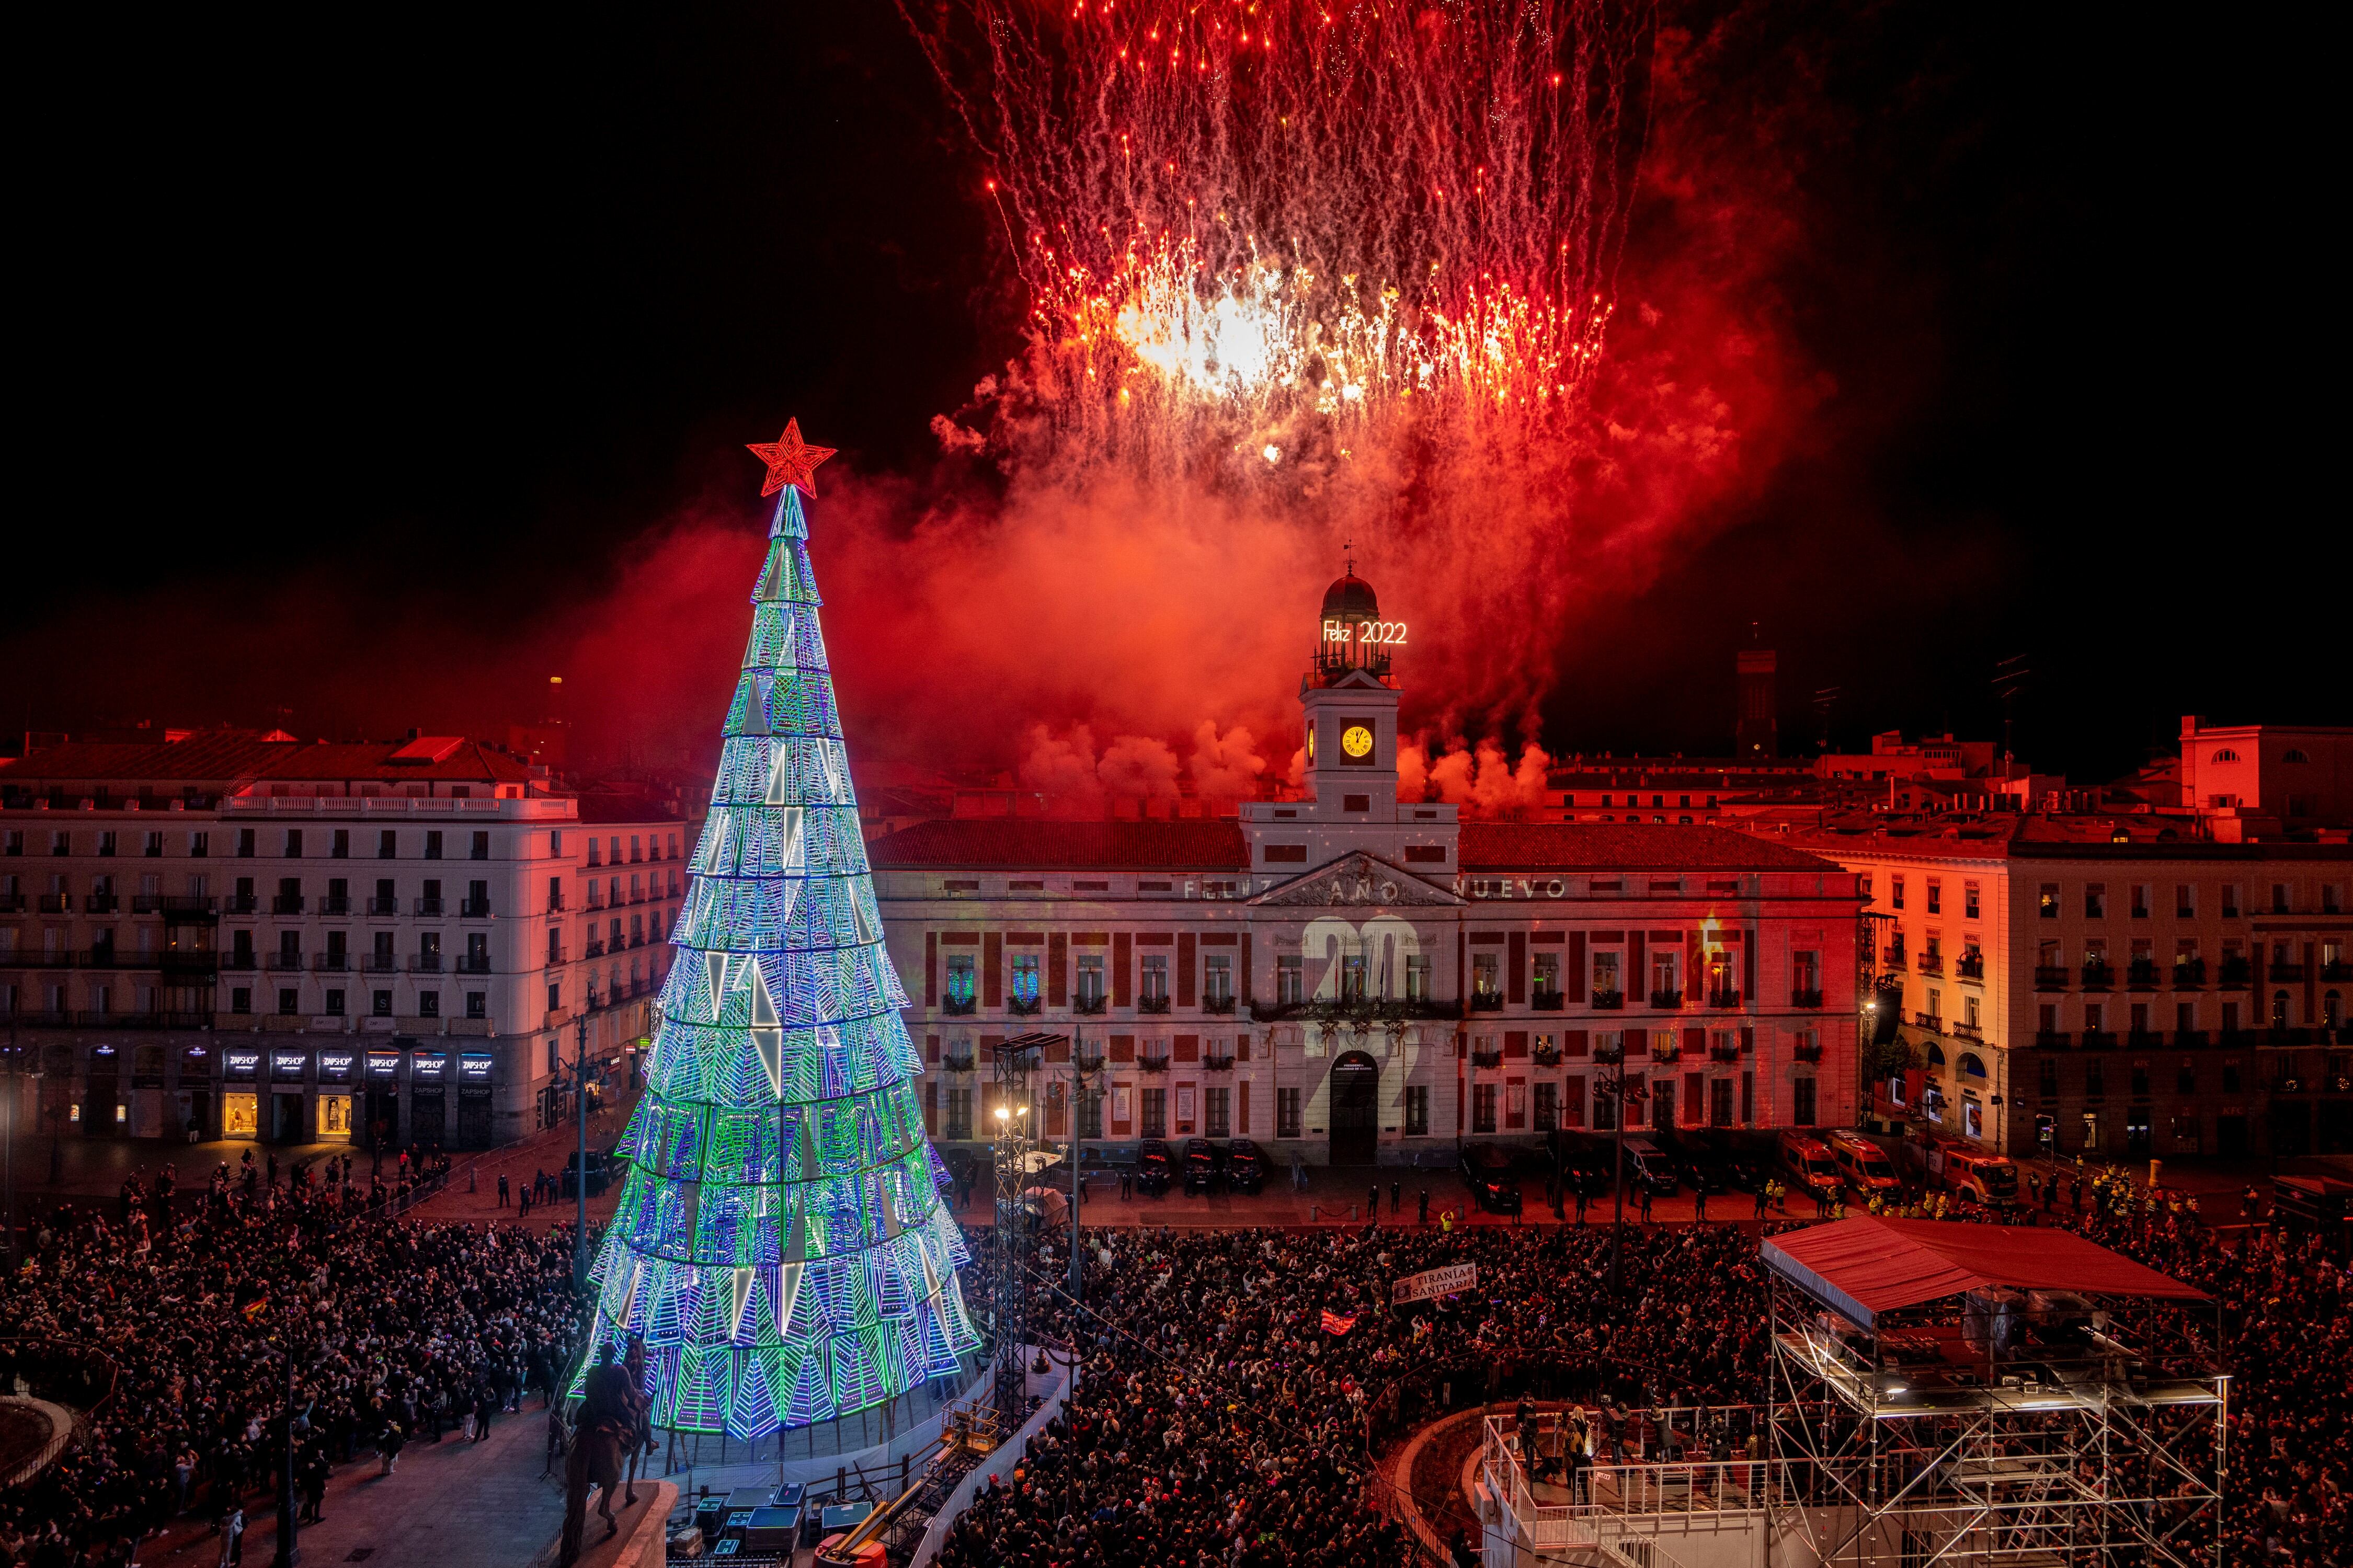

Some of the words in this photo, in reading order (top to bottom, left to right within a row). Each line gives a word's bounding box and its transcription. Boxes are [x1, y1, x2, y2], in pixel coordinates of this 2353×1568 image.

[1324, 621, 1351, 642] Feliz
[1360, 621, 1407, 644] 2022
[1184, 880, 1272, 901] FELIZ
[1331, 879, 1398, 900] AÑO
[1452, 879, 1564, 902] NUEVO
[1301, 915, 1421, 1006] 20
[1413, 1278, 1476, 1297] SANITARIA
[1415, 1268, 1467, 1285] TIRANÍA
